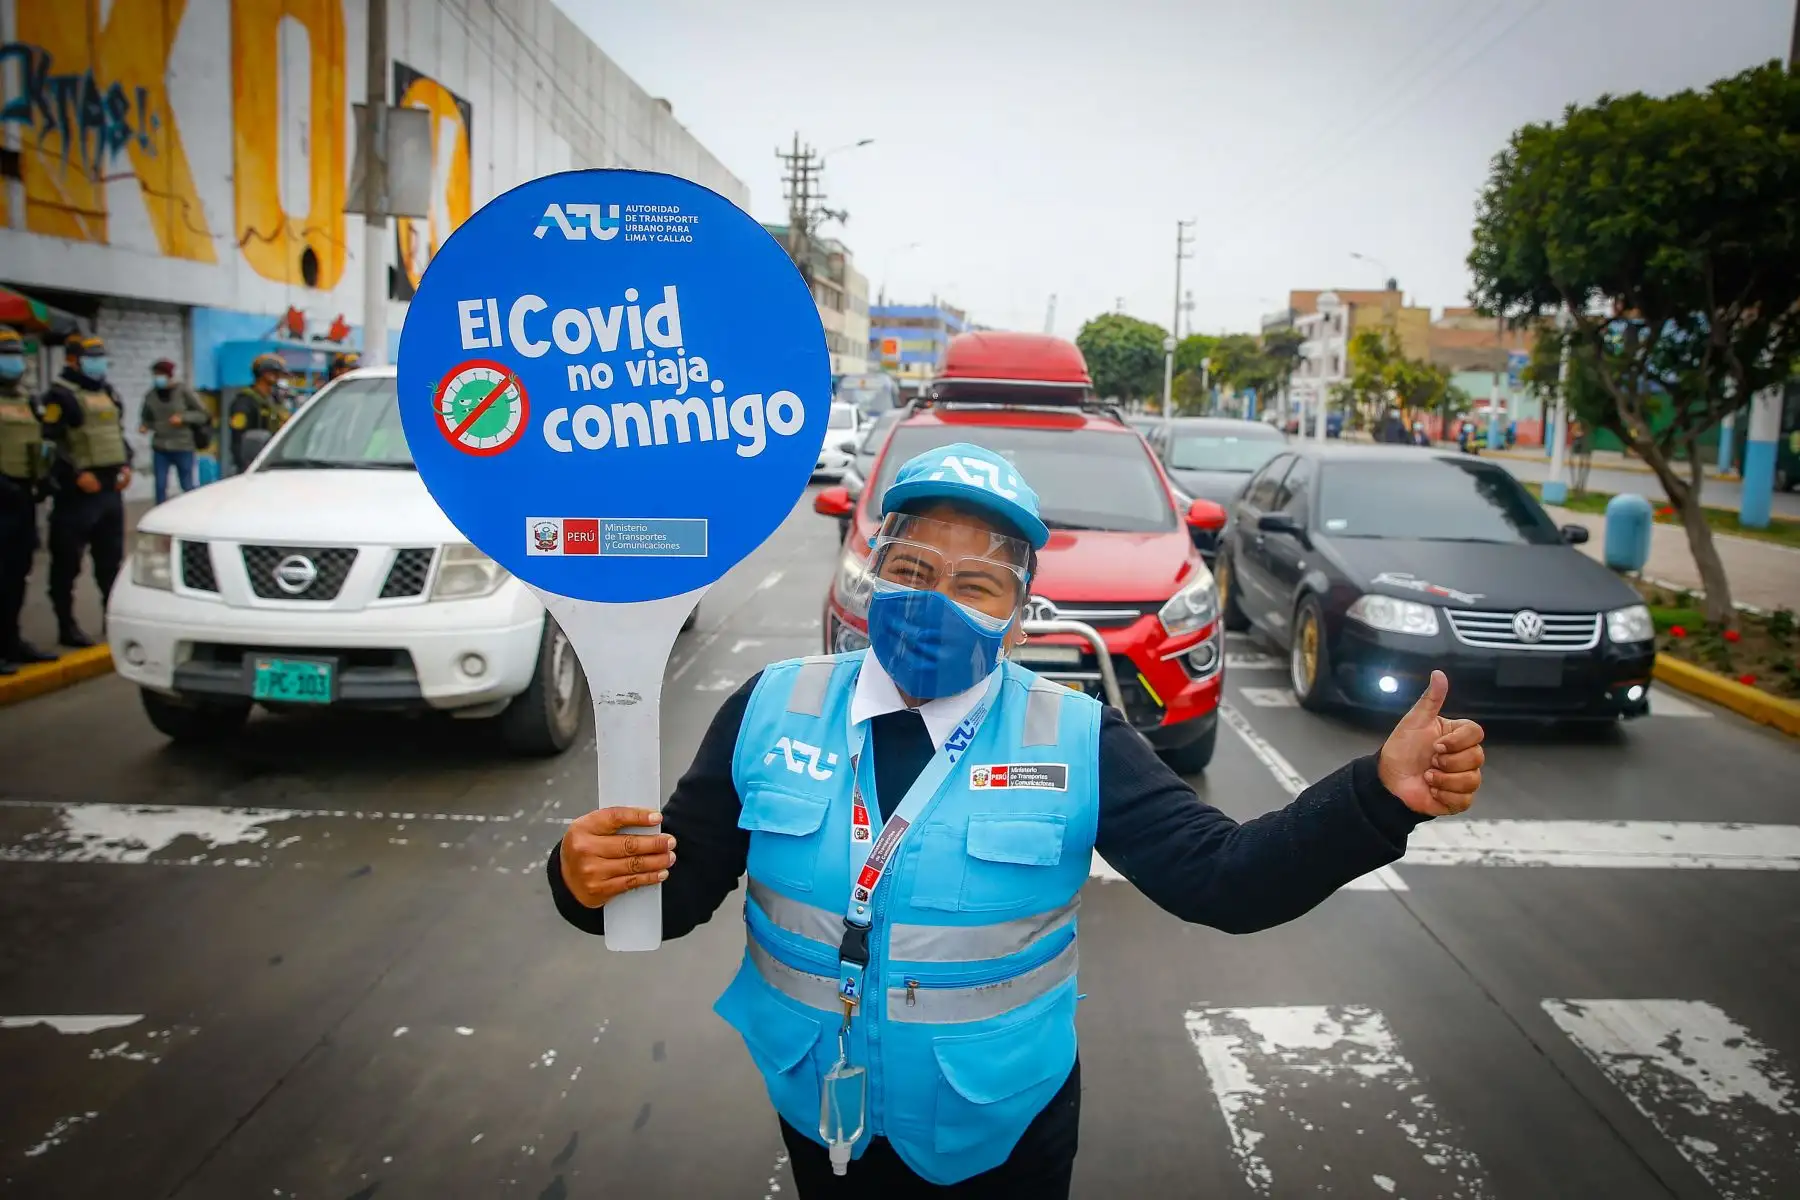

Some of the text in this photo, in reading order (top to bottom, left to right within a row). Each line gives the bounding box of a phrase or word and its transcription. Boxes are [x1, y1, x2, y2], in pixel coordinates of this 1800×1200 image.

[625, 204, 680, 213] AUTORIDAD
[533, 203, 620, 241] ATU
[625, 214, 699, 224] DE TRANSPORTE
[625, 224, 690, 233] URBANO PARA
[625, 233, 693, 243] LIMA Y CALLAO
[457, 285, 683, 358] El Covid
[567, 347, 709, 395] no viaja
[543, 379, 805, 458] conmigo
[929, 456, 1018, 500] ATU
[605, 523, 648, 532] Ministerio
[567, 530, 595, 542] PERÚ
[605, 532, 667, 542] de Transportes
[605, 541, 680, 550] y Comunicaciones
[945, 719, 975, 763] ATU
[763, 736, 839, 781] ATU
[992, 772, 1007, 780] PERÚ
